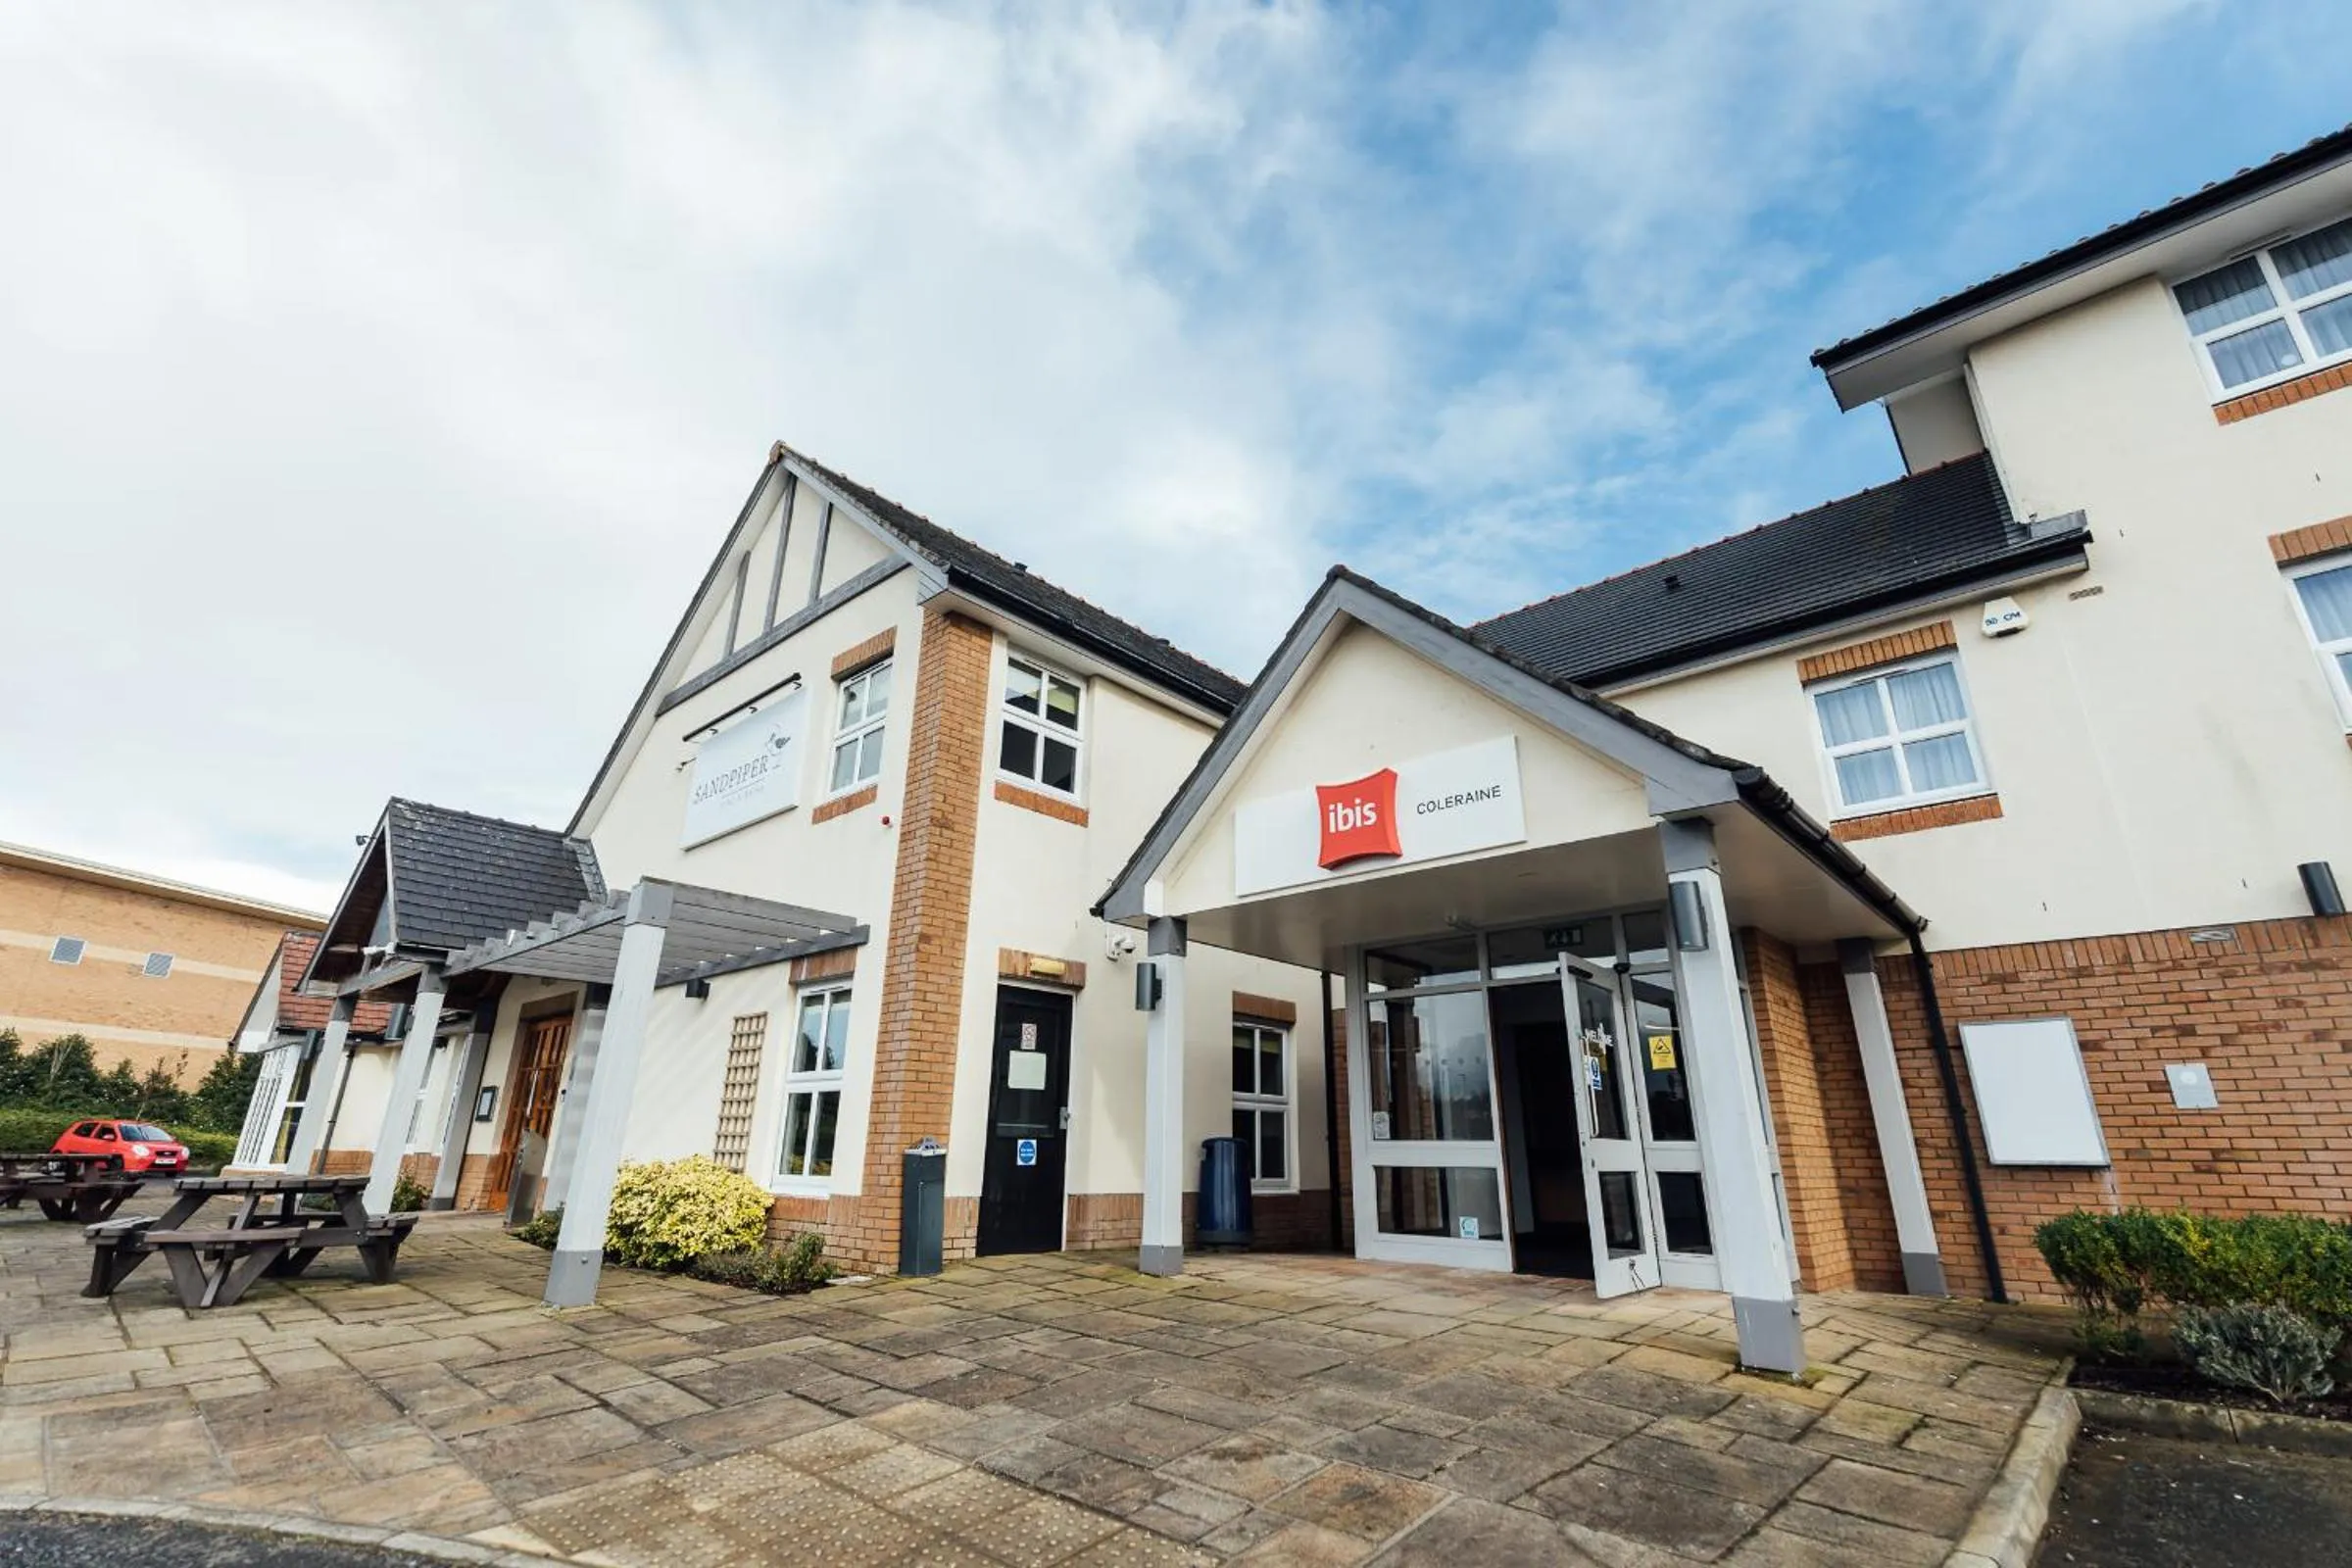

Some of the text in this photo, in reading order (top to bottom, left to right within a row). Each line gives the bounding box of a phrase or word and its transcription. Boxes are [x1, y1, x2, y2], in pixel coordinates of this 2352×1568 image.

[695, 755, 768, 803] SANDPIPER
[1329, 798, 1377, 833] ibis
[1417, 785, 1501, 814] COLERAINE
